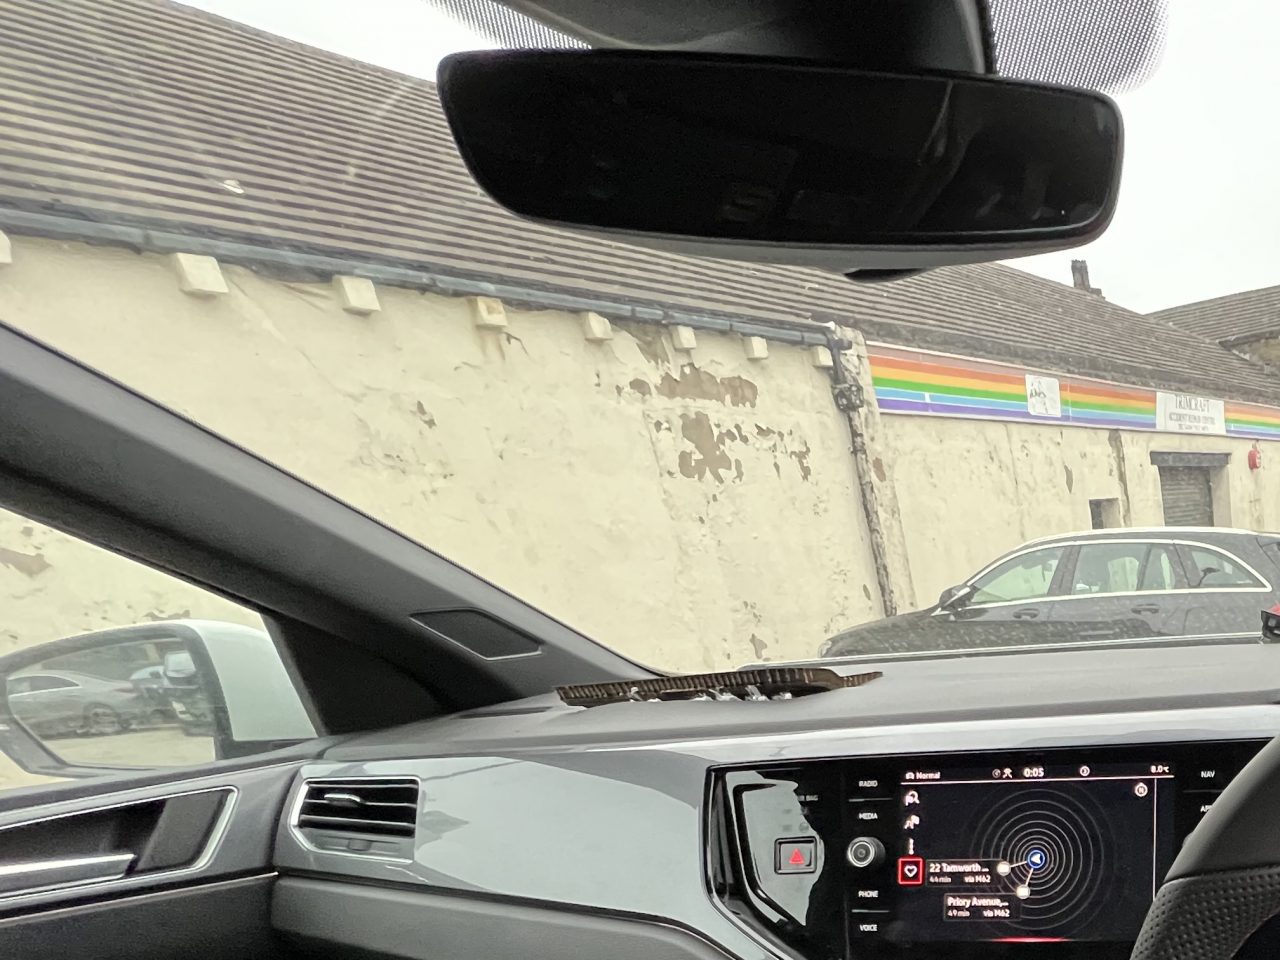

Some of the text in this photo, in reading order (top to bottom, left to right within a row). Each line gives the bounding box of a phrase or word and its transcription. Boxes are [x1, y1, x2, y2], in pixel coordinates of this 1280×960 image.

[916, 771, 941, 780] Normal
[1023, 767, 1045, 778] 0:05
[1201, 770, 1215, 778] NAV
[858, 812, 878, 820] MEDIA
[929, 864, 940, 873] 22
[858, 890, 879, 898] PHONE
[859, 924, 878, 932] VOICE
